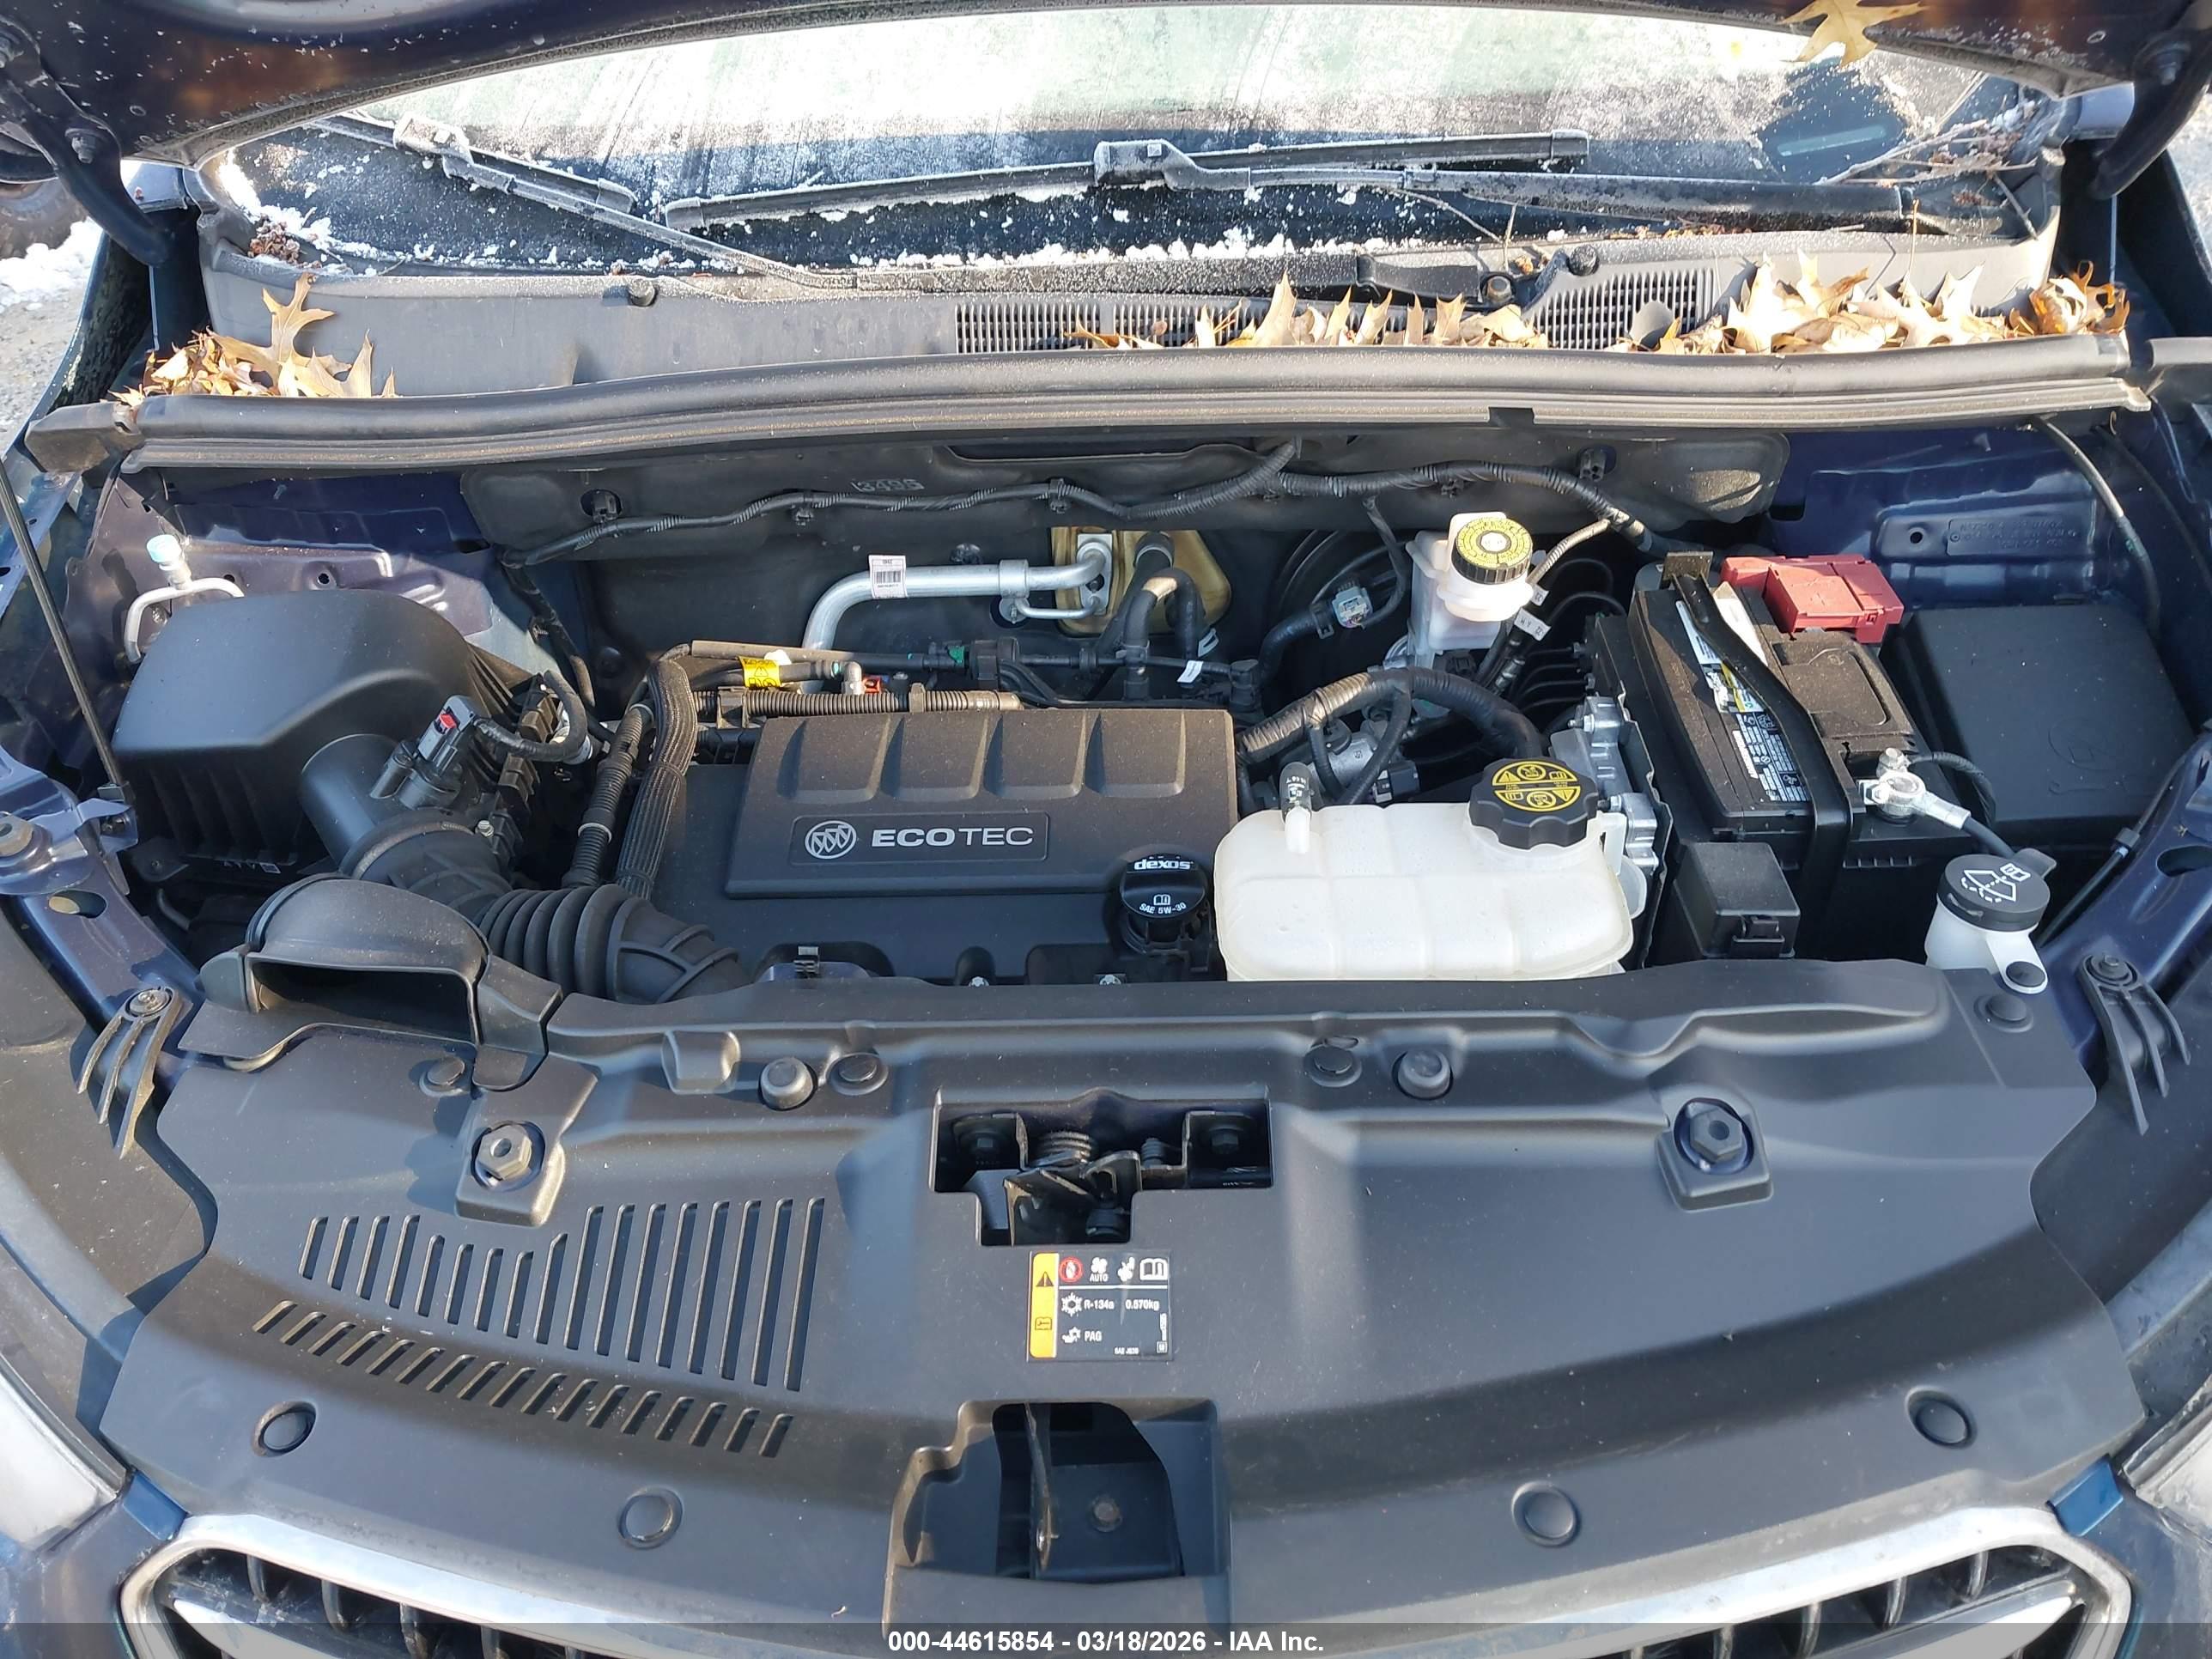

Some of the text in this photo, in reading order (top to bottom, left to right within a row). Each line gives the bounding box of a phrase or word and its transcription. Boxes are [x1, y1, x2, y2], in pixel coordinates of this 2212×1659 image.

[871, 827, 1034, 848] ECOTEC
[1134, 859, 1191, 870] dexos
[1139, 902, 1187, 915] SAE 5W-30
[1089, 1273, 1109, 1282] AUTO
[1084, 1299, 1115, 1310] R-134a
[1084, 1331, 1103, 1341] PAG
